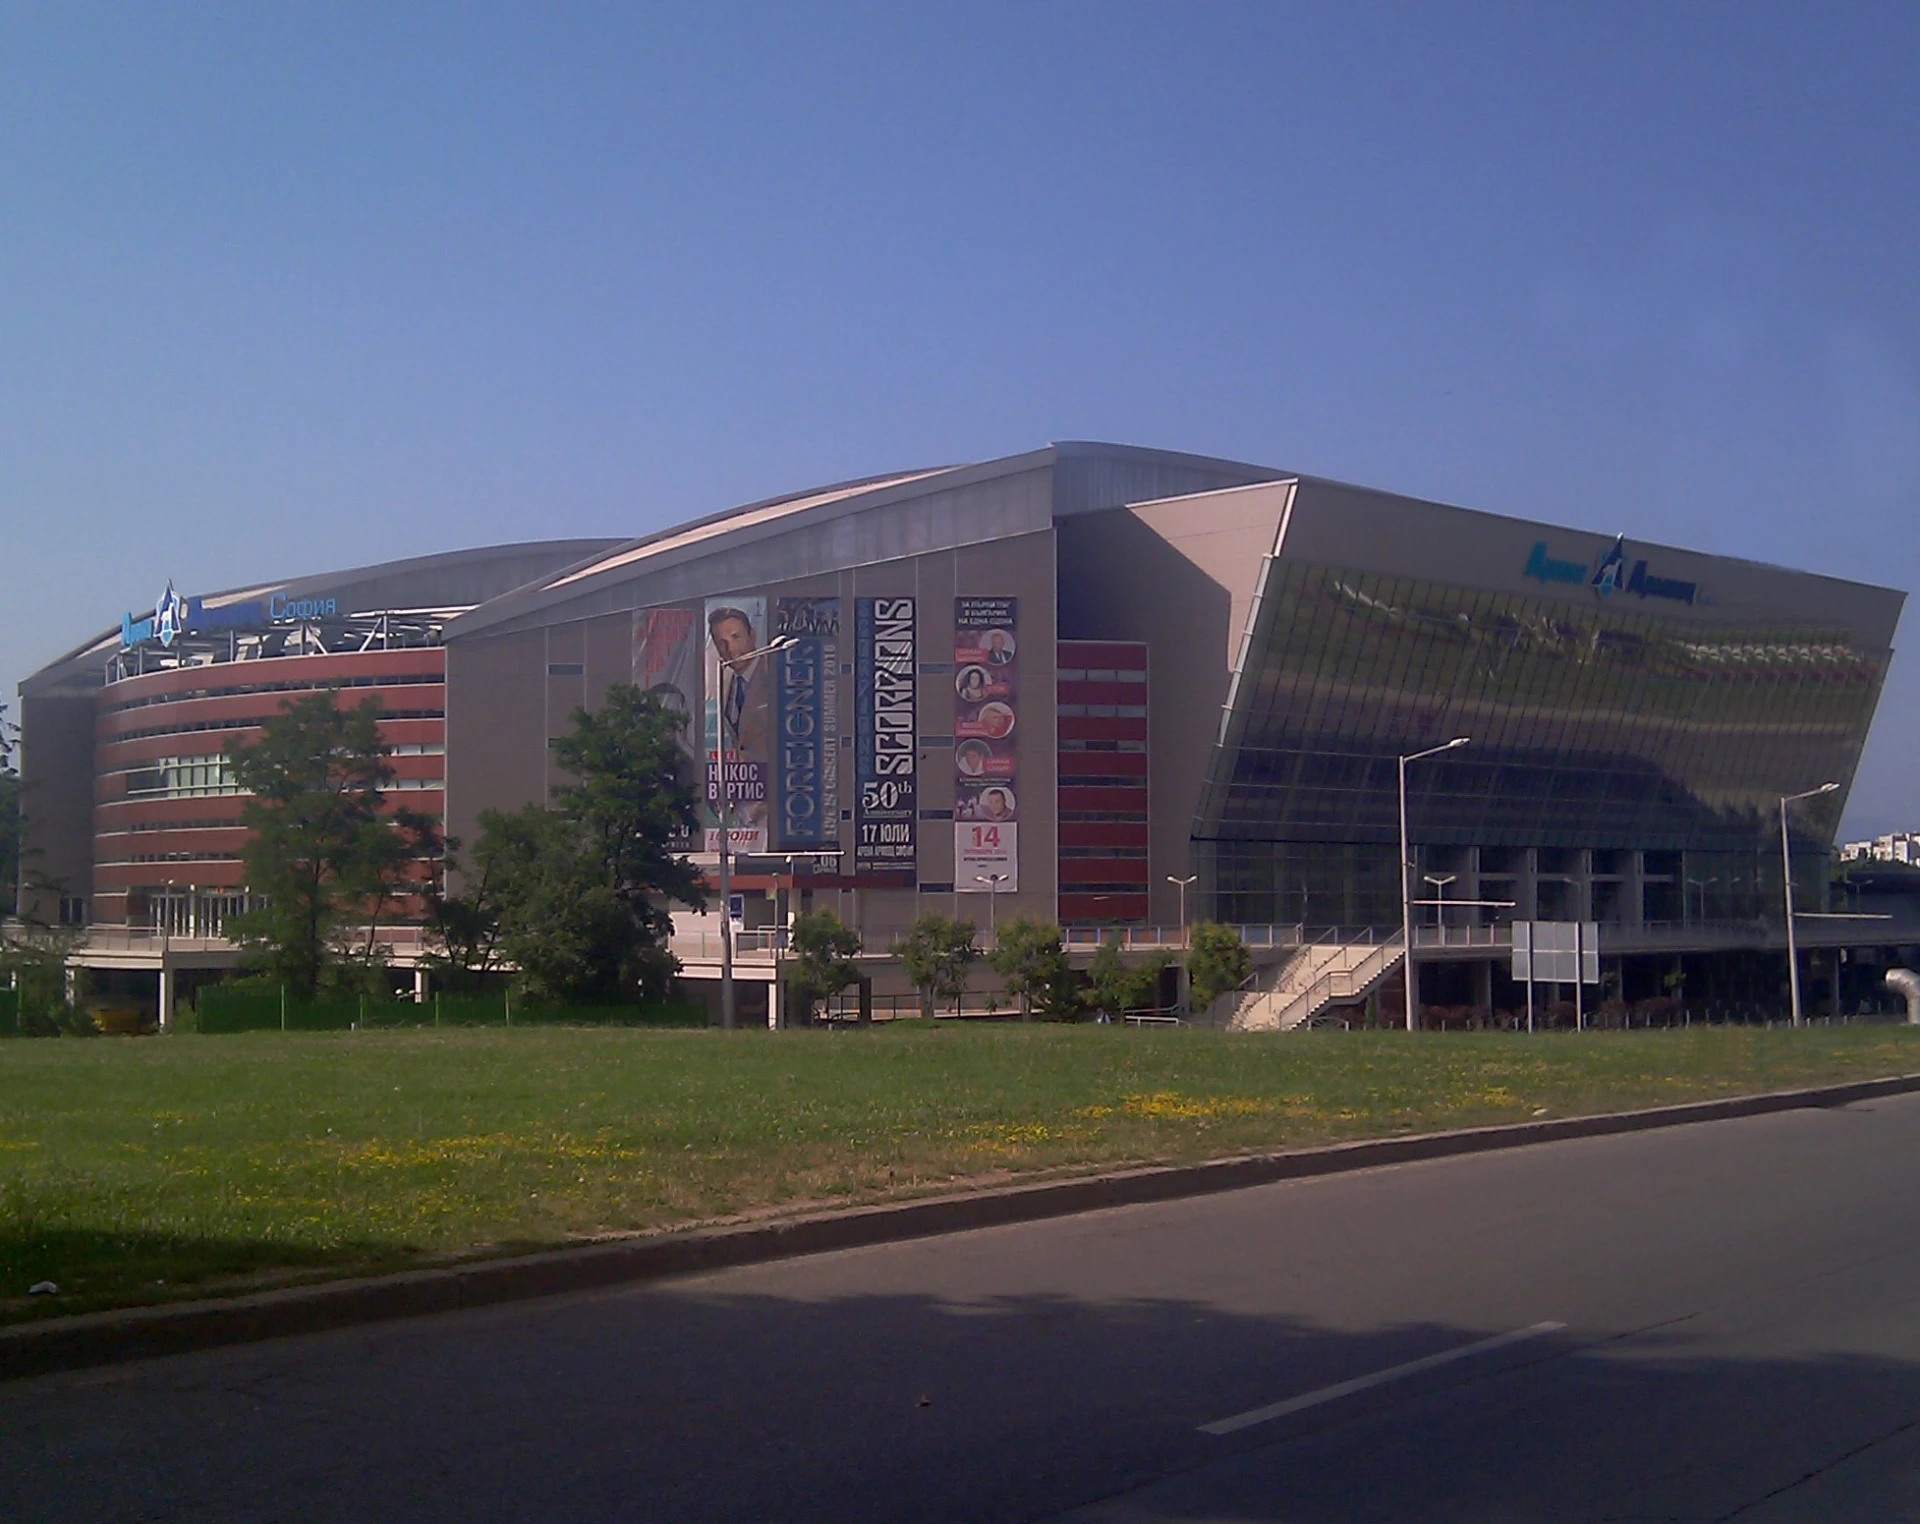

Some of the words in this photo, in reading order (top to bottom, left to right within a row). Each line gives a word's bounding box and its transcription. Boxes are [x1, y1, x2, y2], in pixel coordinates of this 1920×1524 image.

[269, 592, 336, 619] София
[874, 598, 913, 775] SCORPIONS
[823, 679, 837, 732] SUMMER
[785, 643, 815, 836] FOREIGNER
[708, 782, 764, 799] ВРТИС
[862, 824, 877, 842] 17
[880, 824, 909, 842] ЮЛИ
[971, 826, 1000, 847] 14
